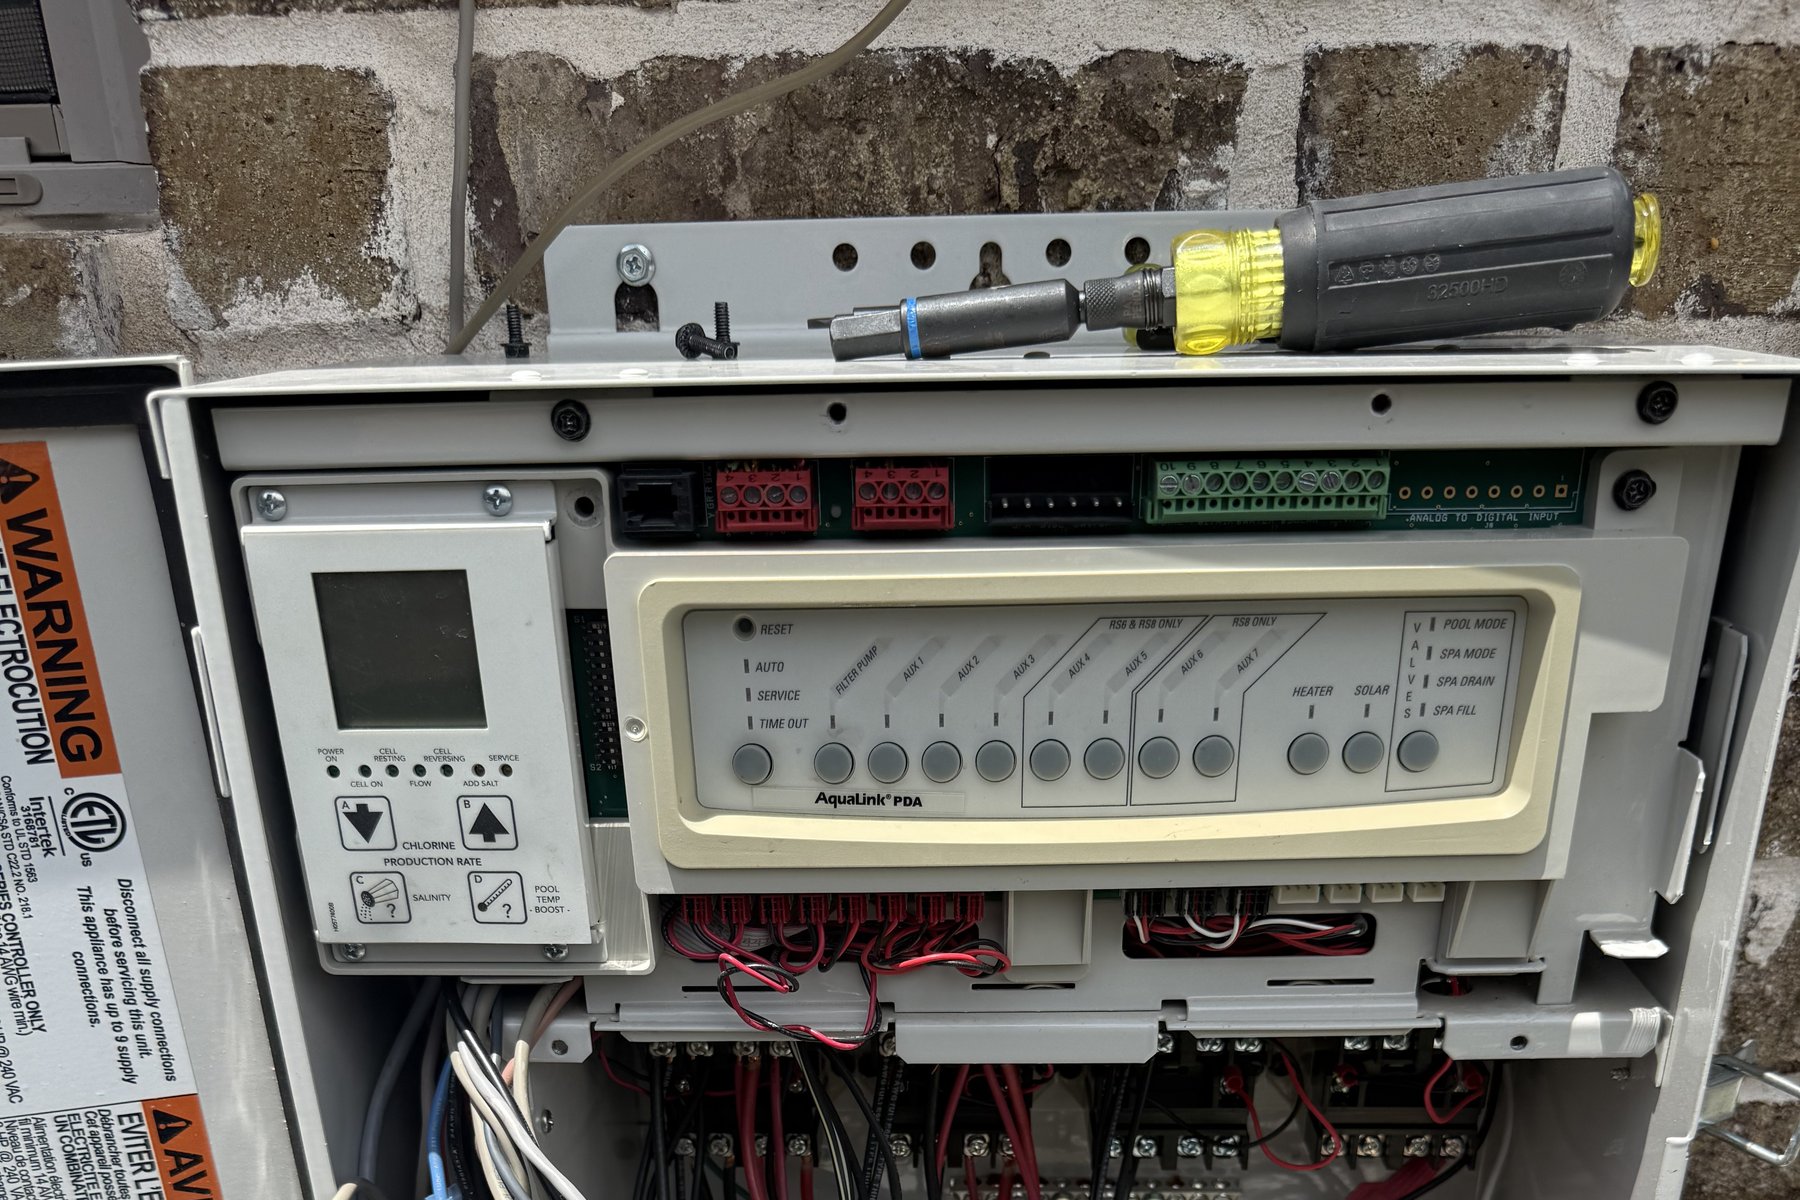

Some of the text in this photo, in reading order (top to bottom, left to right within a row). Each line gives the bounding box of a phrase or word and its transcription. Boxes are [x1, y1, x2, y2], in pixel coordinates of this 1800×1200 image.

[1409, 513, 1559, 522] ANALOG TO DIGITAL INPUT
[761, 623, 793, 635] RESET
[1109, 619, 1183, 629] RS6 & RS8 ONLY
[1232, 617, 1277, 627] RS8 ONLY
[1443, 618, 1508, 629] POOL MODE
[4, 507, 106, 765] WARNING
[1181, 649, 1204, 676] AUX 6
[1236, 649, 1260, 674] AUX 7
[1440, 648, 1497, 659] SPA MODE
[755, 661, 785, 672] AUTO
[835, 645, 878, 695] FILTER PUMP
[903, 664, 920, 682] AUX
[958, 655, 980, 681] AUX 2
[1013, 654, 1036, 680] AUX 3
[1068, 653, 1091, 679] AUX 4
[1125, 651, 1148, 677] AUX 5
[1354, 685, 1390, 695] SOLAR
[1436, 676, 1495, 687] SPA DRAIN
[757, 690, 800, 701] SERVICE
[1292, 686, 1333, 697] HEATER
[1433, 705, 1477, 716] SPA FILL
[760, 718, 809, 729] TIME OUT
[424, 755, 465, 763] REVERSING
[342, 801, 350, 810] A
[463, 800, 471, 808] B
[894, 795, 923, 807] PDA
[0, 774, 38, 883] Conforms to UL STD 1563
[20, 804, 40, 849] 3168781
[28, 794, 58, 858] Intertek
[0, 832, 14, 851] STD
[402, 842, 455, 850] CHLORINE
[5, 852, 22, 878] C22.2
[79, 851, 92, 867] US
[384, 858, 482, 867] PRODUCTION RATE
[13, 878, 26, 895] NO.
[356, 876, 364, 884] C
[474, 875, 482, 883] D
[413, 894, 451, 902] SALINITY
[534, 885, 559, 893] POOL
[18, 896, 33, 919] 218.1
[0, 955, 19, 986] AWG
[1, 912, 36, 998] CONTROLLER
[24, 1000, 46, 1034] ONLY
[116, 876, 179, 1083] Disconnect all supply connections
[71, 949, 103, 1028] connections.
[76, 885, 139, 1086] This appliance has up to 9 supply
[102, 906, 153, 1059] before servicing this unit.
[6, 986, 24, 1009] wire
[10, 1009, 33, 1037] min.)
[0, 1059, 15, 1079] 240
[4, 1080, 23, 1104] VAC
[52, 1114, 69, 1133] UN
[82, 1109, 100, 1129] Cet
[66, 1111, 100, 1190] ELECTRICITE
[85, 1129, 112, 1171] appareil
[114, 1110, 158, 1175] EVITER
[95, 1107, 124, 1169] Débrancher
[112, 1167, 134, 1200] toutes
